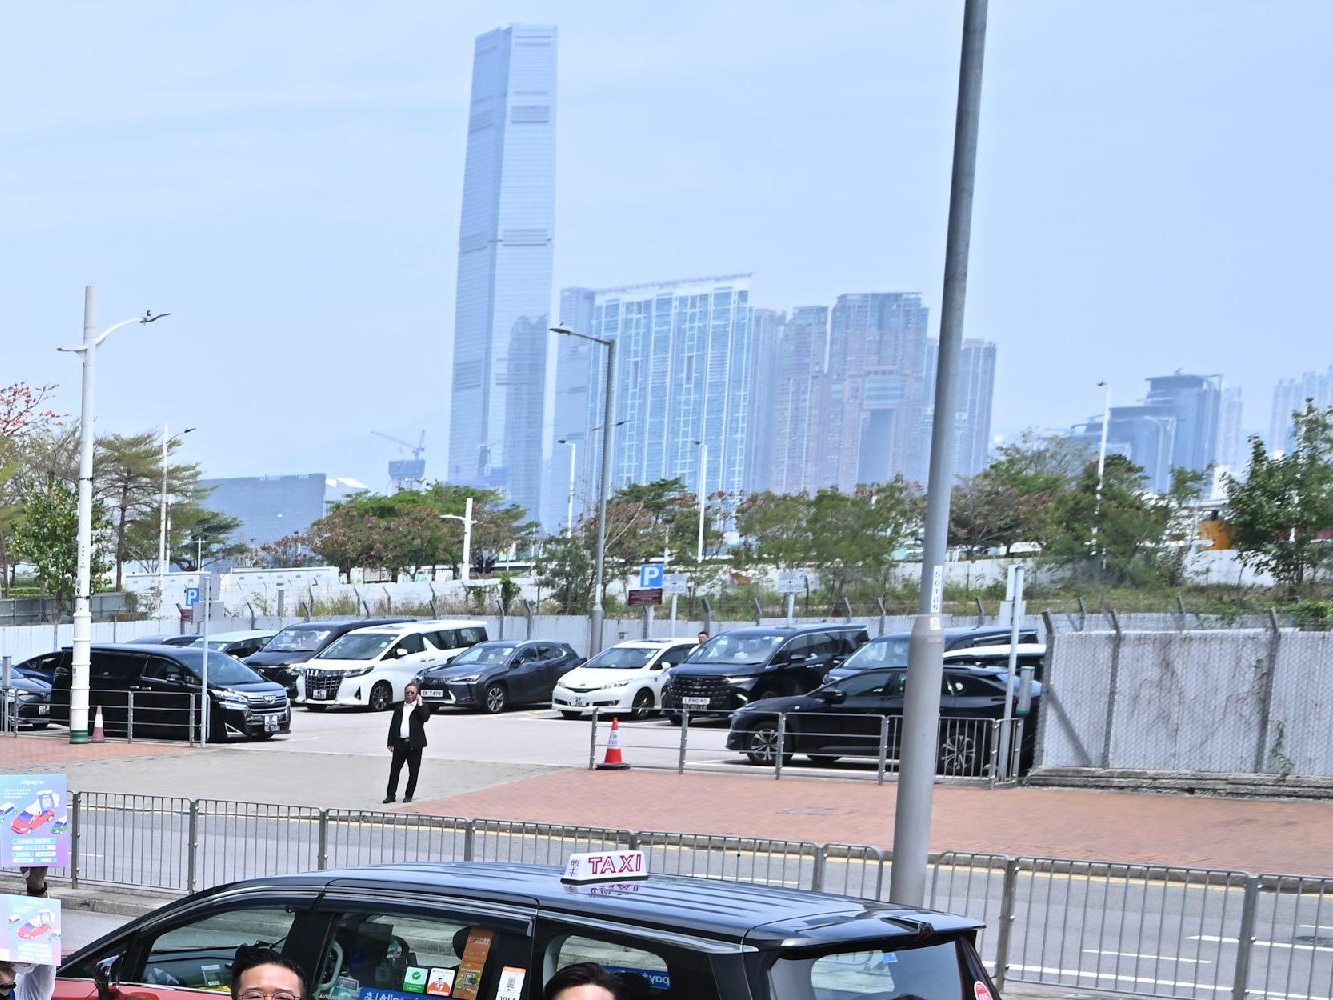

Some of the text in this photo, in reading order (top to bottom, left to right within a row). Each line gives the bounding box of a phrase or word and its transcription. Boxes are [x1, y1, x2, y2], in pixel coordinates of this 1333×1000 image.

[643, 566, 660, 586] P
[188, 588, 198, 601] P
[588, 853, 642, 875] TAXI
